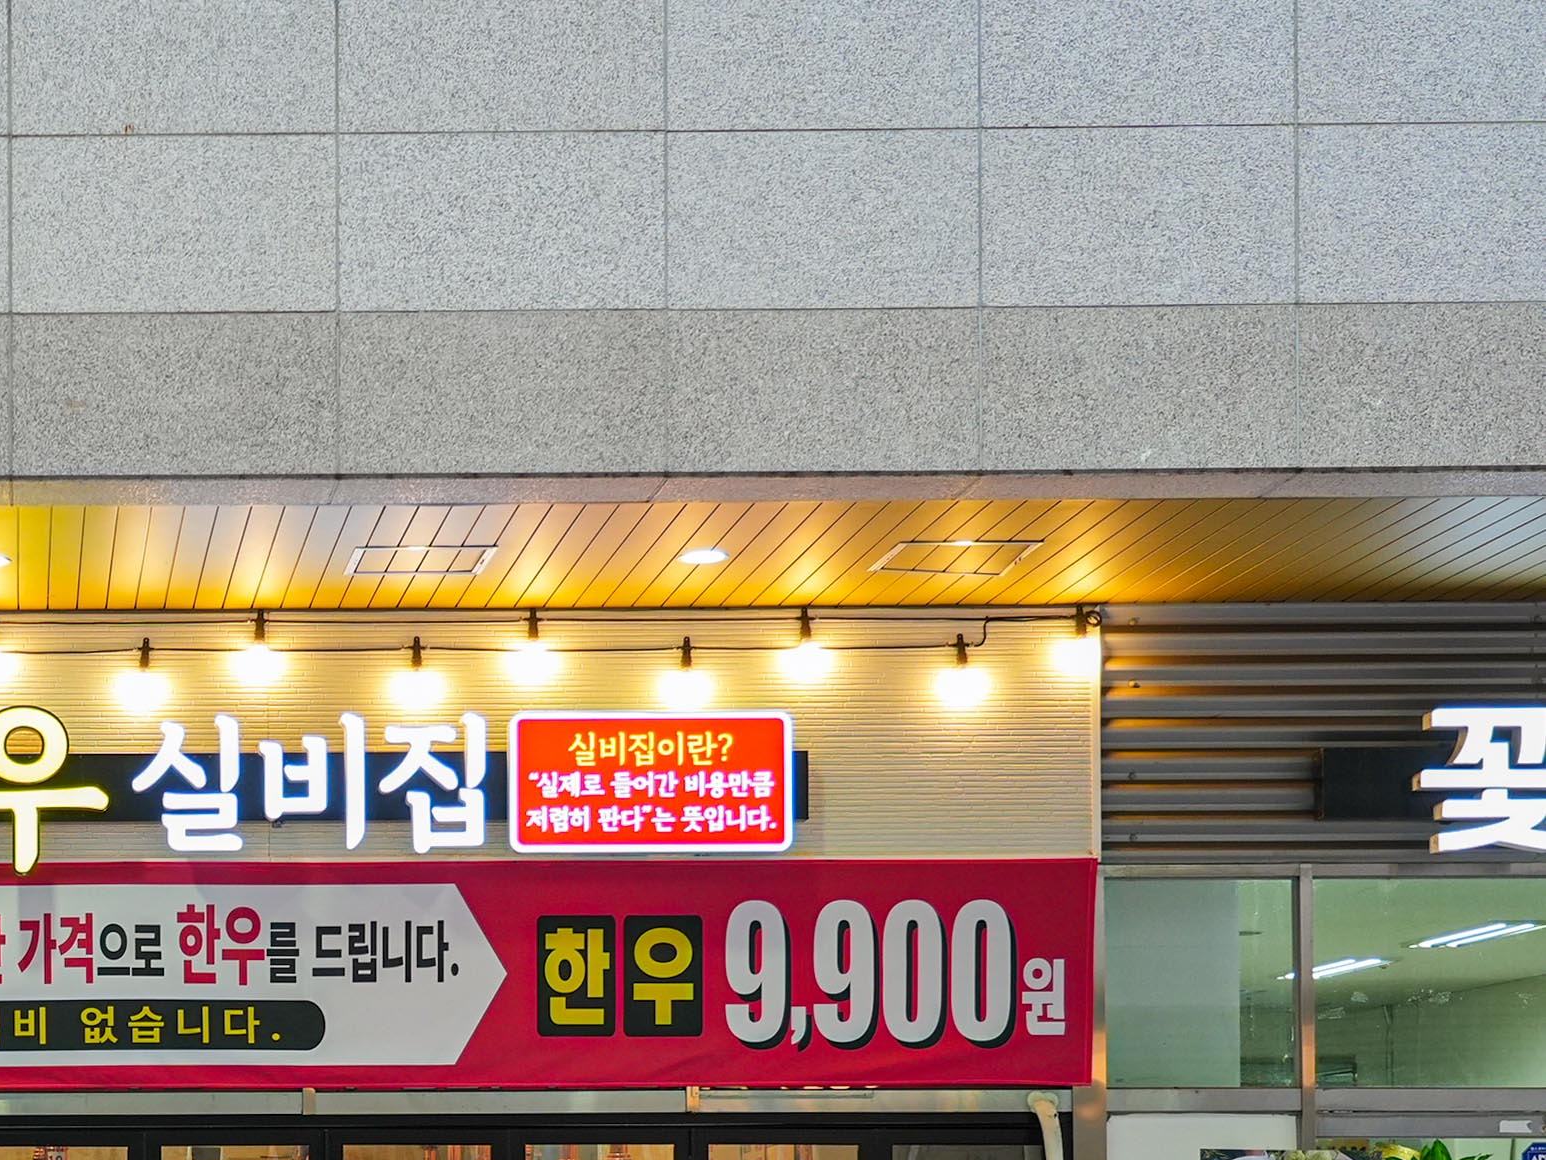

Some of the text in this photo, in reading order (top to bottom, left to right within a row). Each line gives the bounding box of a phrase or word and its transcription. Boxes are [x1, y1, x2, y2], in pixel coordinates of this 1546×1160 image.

[568, 731, 733, 767] 실비집이란?
[131, 710, 488, 855] 실비집
[610, 771, 679, 799] 들어간
[684, 771, 775, 799] 비용만큼
[1414, 706, 1546, 854] 꽃
[526, 806, 590, 834] 저렴히
[680, 805, 777, 833] 뜻입니다.
[17, 912, 164, 986] 가격으로
[176, 904, 300, 986] 한우를
[312, 920, 459, 984] 드립니다.
[544, 899, 1066, 1048] 한우 9,900원
[80, 1005, 281, 1045] 없습니다.
